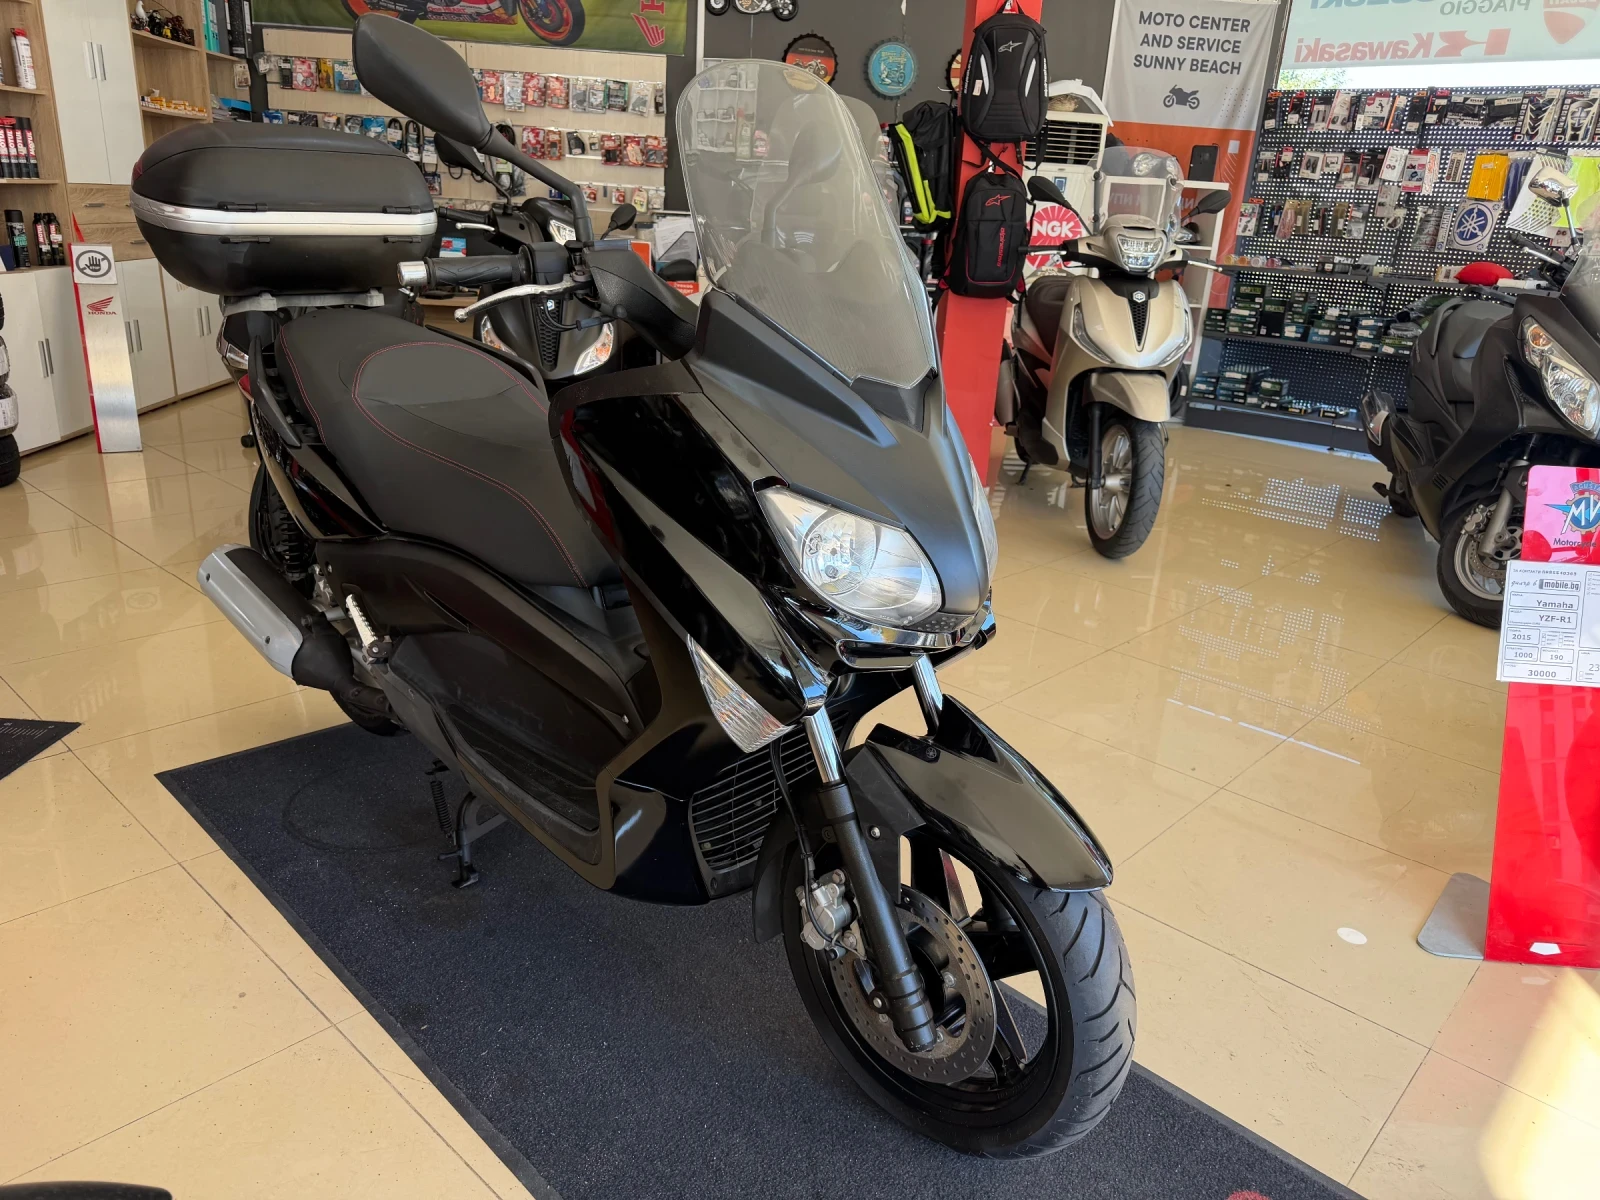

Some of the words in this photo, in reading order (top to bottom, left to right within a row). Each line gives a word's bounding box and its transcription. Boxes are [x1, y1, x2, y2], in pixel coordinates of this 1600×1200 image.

[1138, 11, 1185, 28] MOTO
[1189, 15, 1251, 33] CENTER
[1140, 33, 1173, 48] AND
[1177, 36, 1242, 54] SERVICE
[1133, 54, 1187, 71] SUNNY
[1189, 58, 1242, 75] BEACH
[36, 225, 44, 243] MOTUL
[1032, 220, 1075, 238] NGK
[1544, 581, 1580, 591] mobile.bg
[1536, 600, 1574, 609] Yamaha
[1538, 615, 1572, 624] YZF-R1
[1512, 633, 1532, 641] 2015
[1527, 669, 1557, 678] 30000
